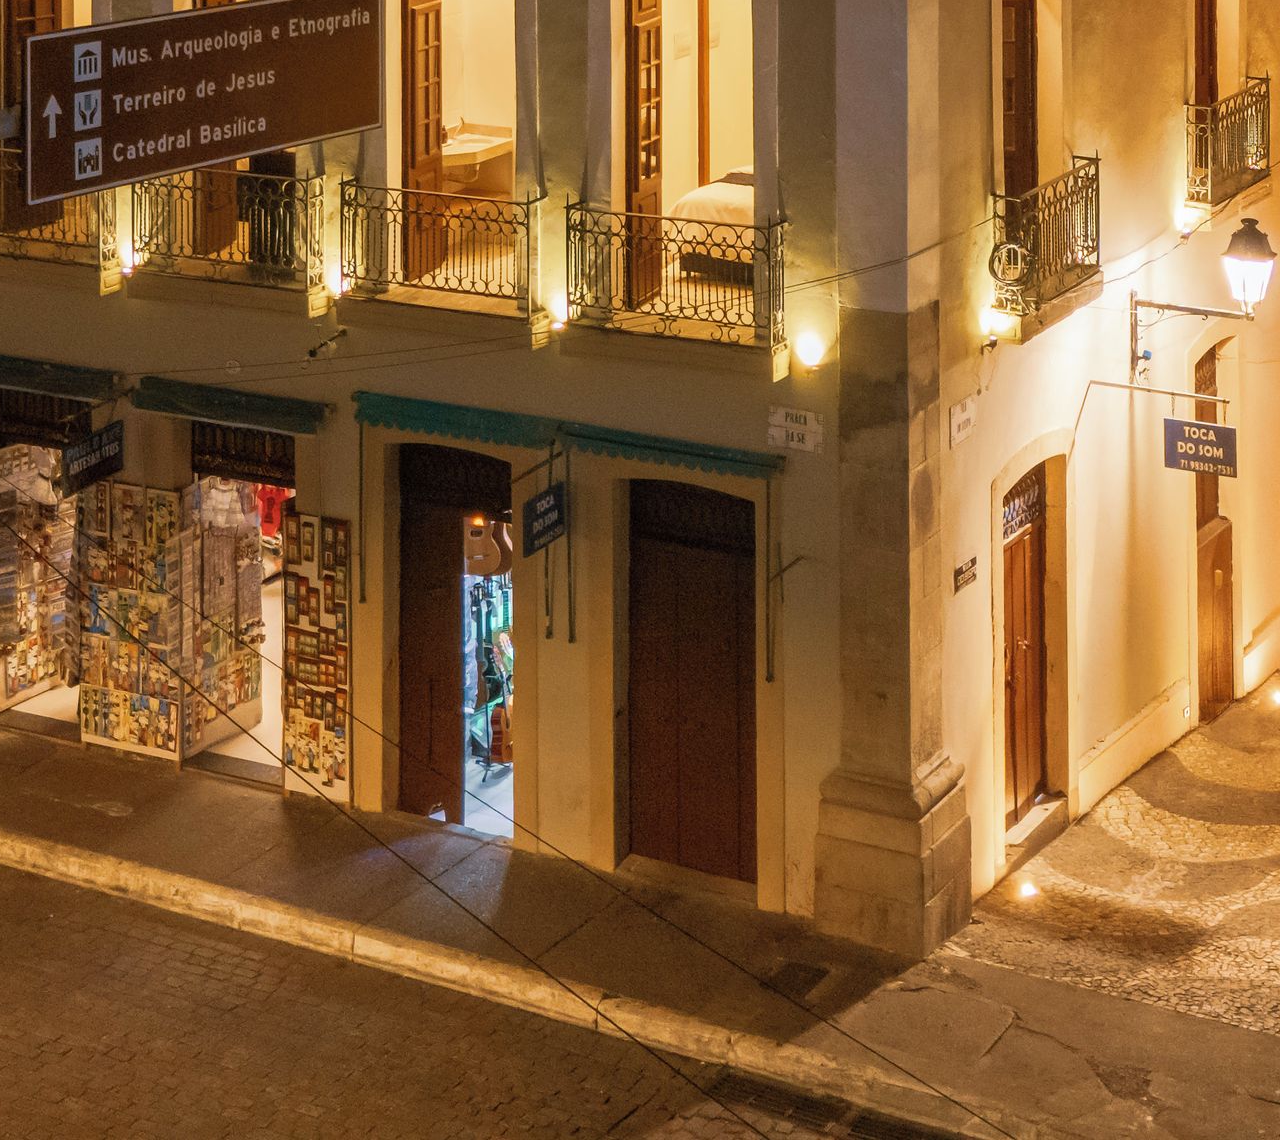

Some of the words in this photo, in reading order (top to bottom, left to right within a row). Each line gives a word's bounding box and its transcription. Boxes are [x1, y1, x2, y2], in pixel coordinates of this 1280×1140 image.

[112, 47, 152, 68] Mus.
[161, 25, 263, 60] Arqueologia
[271, 25, 280, 39] e
[288, 8, 371, 38] Etnografia
[112, 85, 186, 115] Terreiro
[196, 78, 216, 98] de
[225, 69, 276, 92] Jesus
[113, 127, 191, 163] Catedral
[200, 115, 267, 143] Basílica
[1177, 441, 1196, 455] DO
[1198, 444, 1223, 460] SOM
[1183, 426, 1217, 442] TOCA
[536, 494, 555, 514] TOCA
